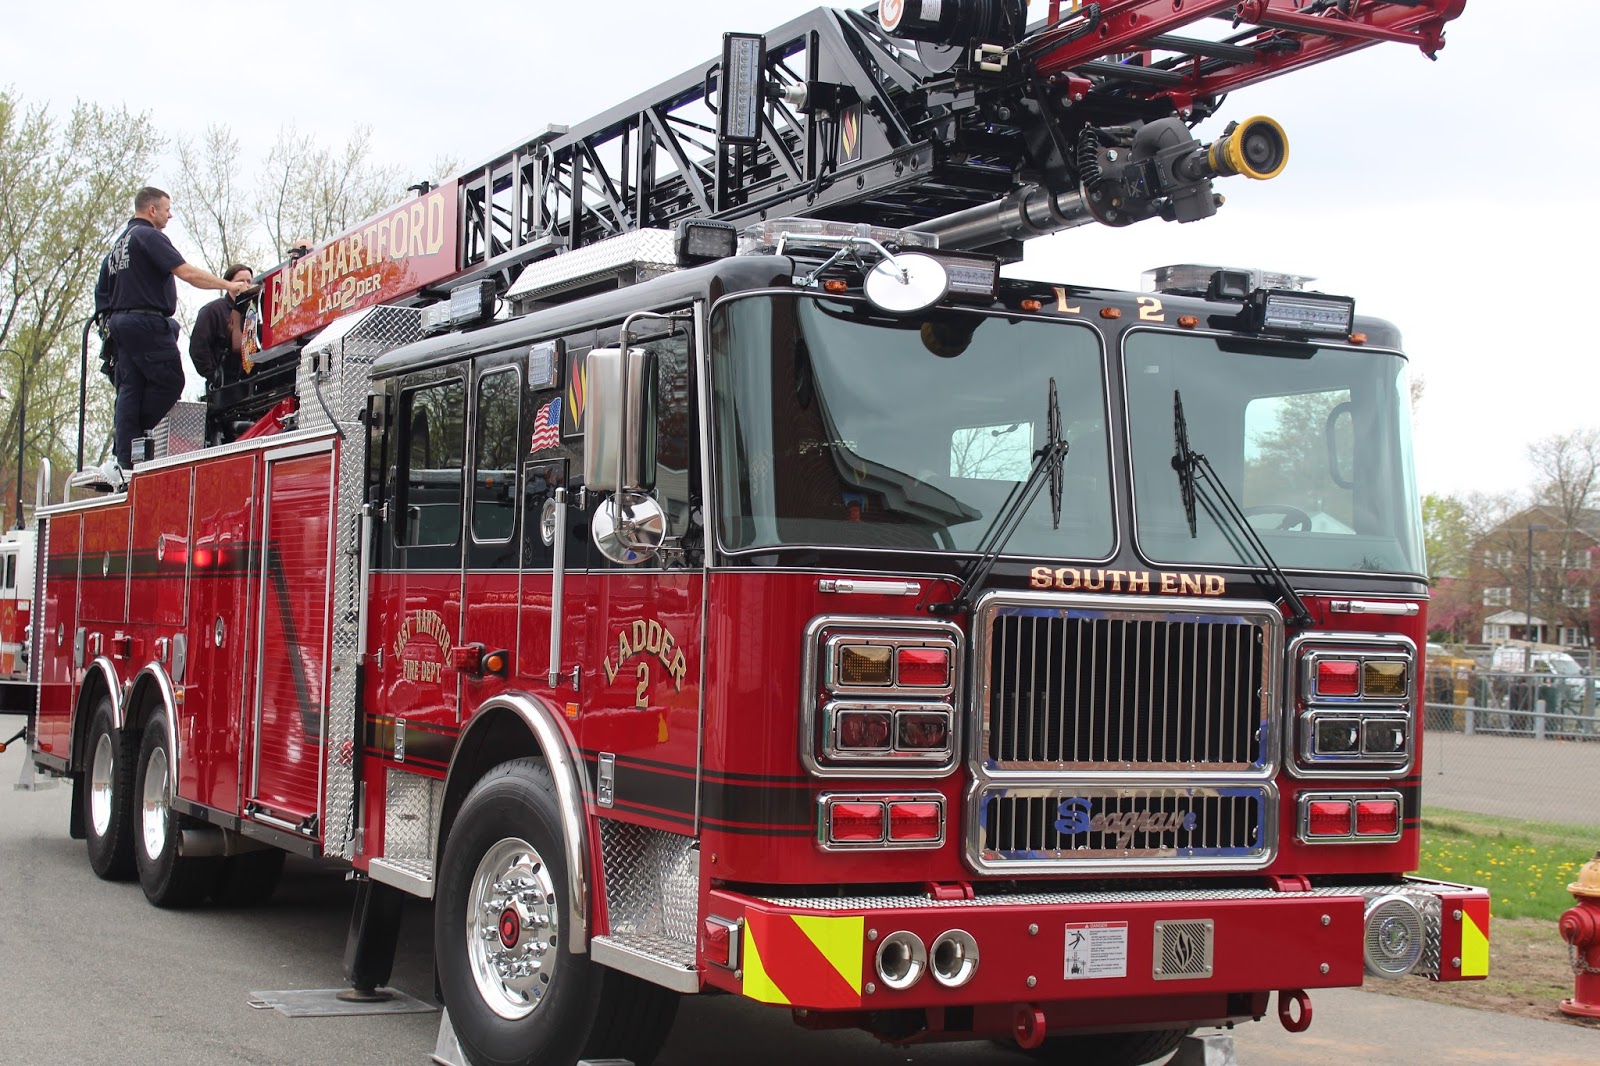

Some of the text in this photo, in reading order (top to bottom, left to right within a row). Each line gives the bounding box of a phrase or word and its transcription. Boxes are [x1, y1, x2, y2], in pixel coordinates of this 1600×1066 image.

[270, 192, 445, 328] EAST HARTFORD
[1053, 287, 1165, 322] L 2
[1029, 566, 1226, 597] SOUTH END
[393, 616, 411, 661] EAST
[603, 618, 688, 693] LADDER
[402, 659, 419, 681] FIRE
[635, 661, 650, 709] 2
[1054, 797, 1198, 849] Seagrave
